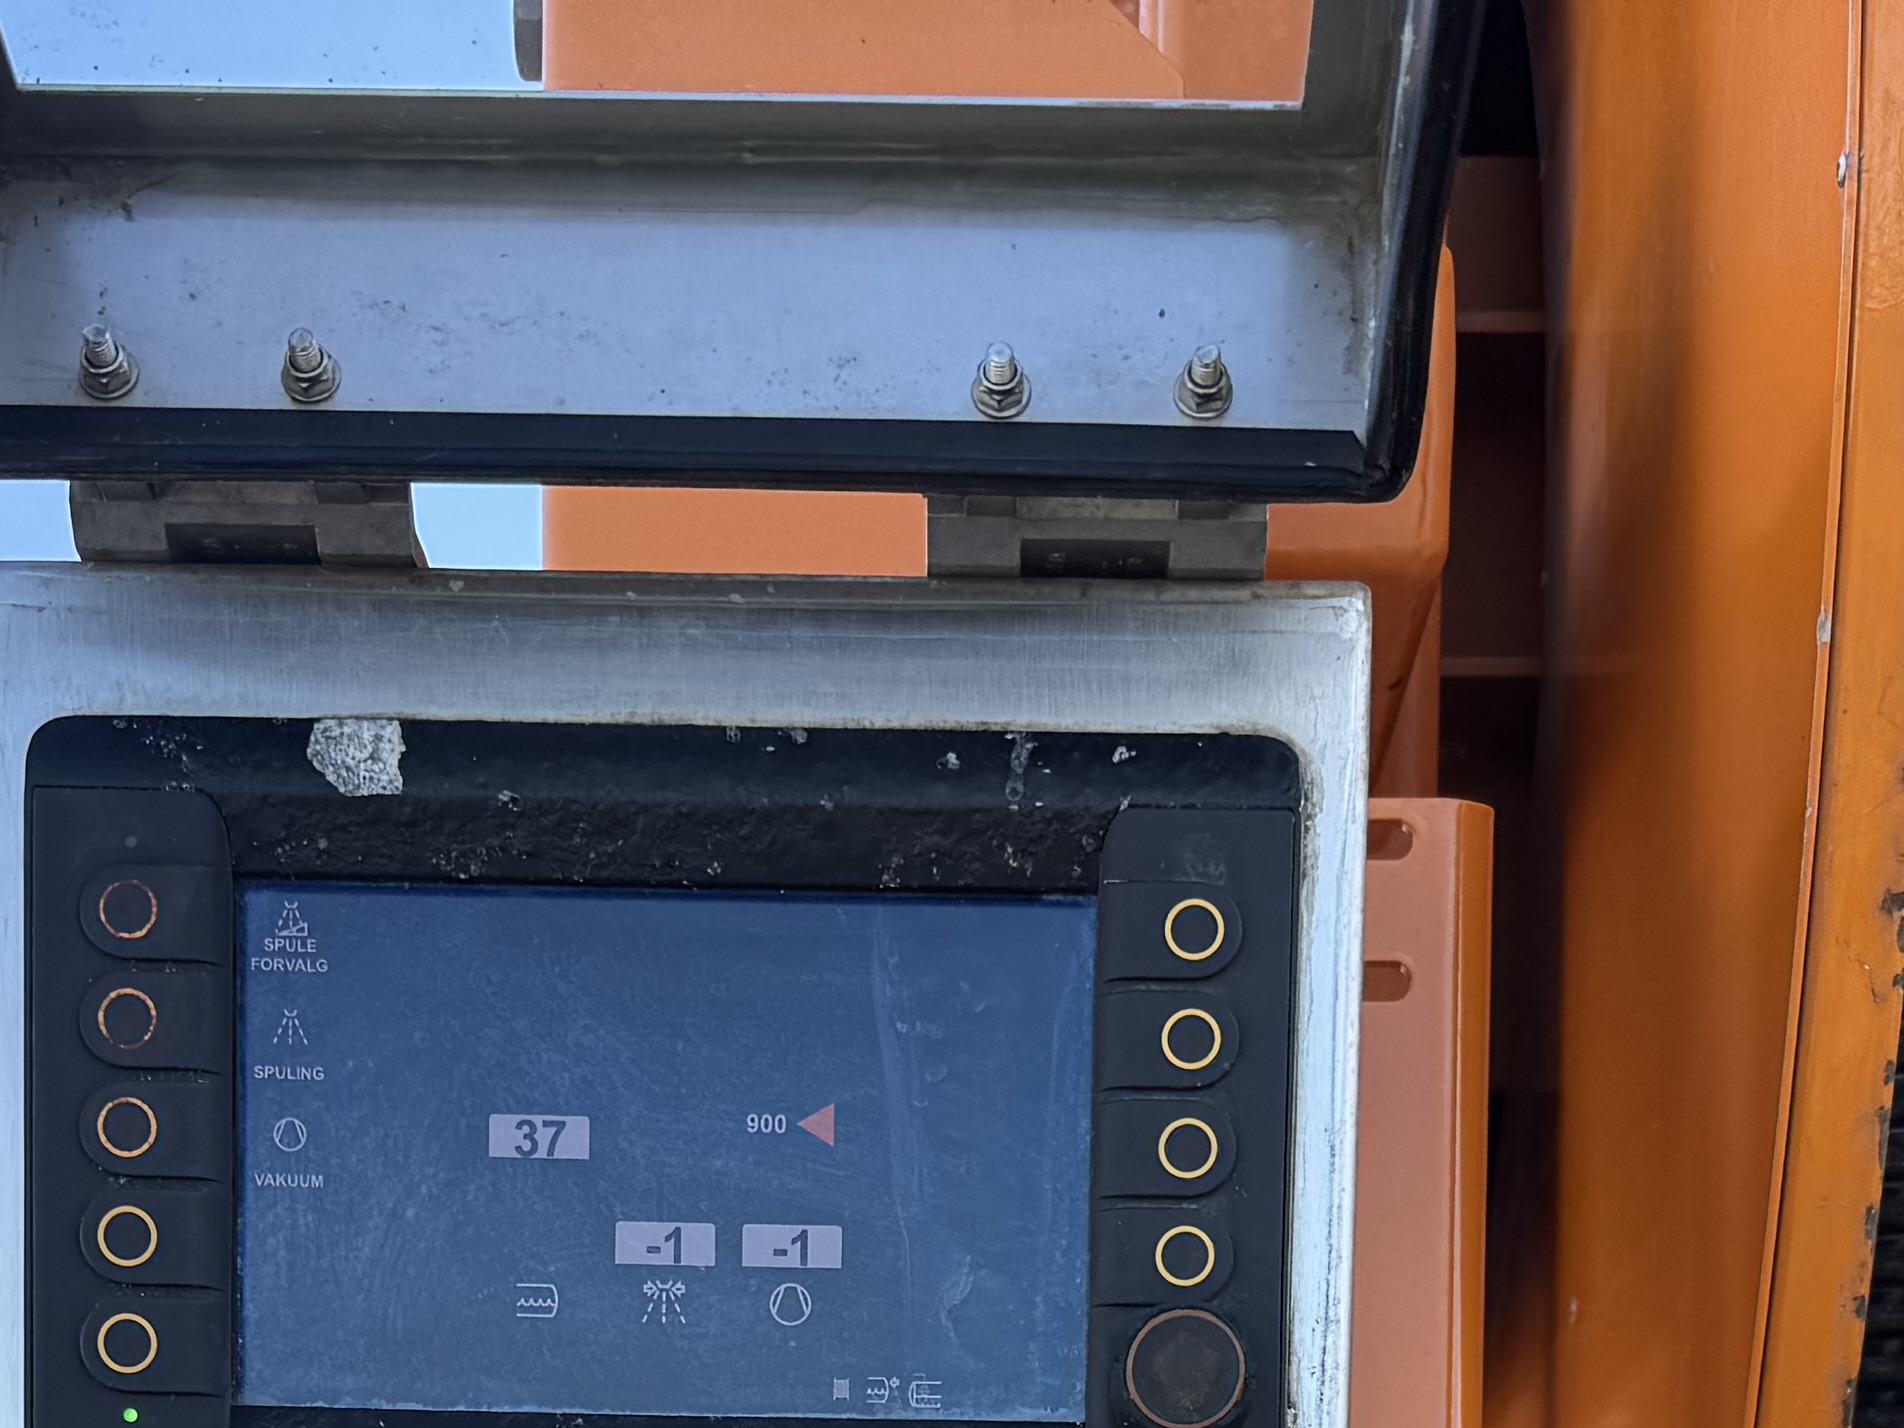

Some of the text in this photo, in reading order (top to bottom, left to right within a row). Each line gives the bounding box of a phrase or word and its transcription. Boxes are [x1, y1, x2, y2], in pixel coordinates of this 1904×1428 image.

[264, 938, 317, 953] SPULE
[250, 957, 329, 973] FORVALG
[253, 1065, 325, 1081] SPULING
[746, 1113, 787, 1134] 900
[514, 1119, 567, 1158] 37
[254, 1172, 324, 1189] VAKUUM
[646, 1226, 682, 1265] -1
[772, 1228, 809, 1267] -1
